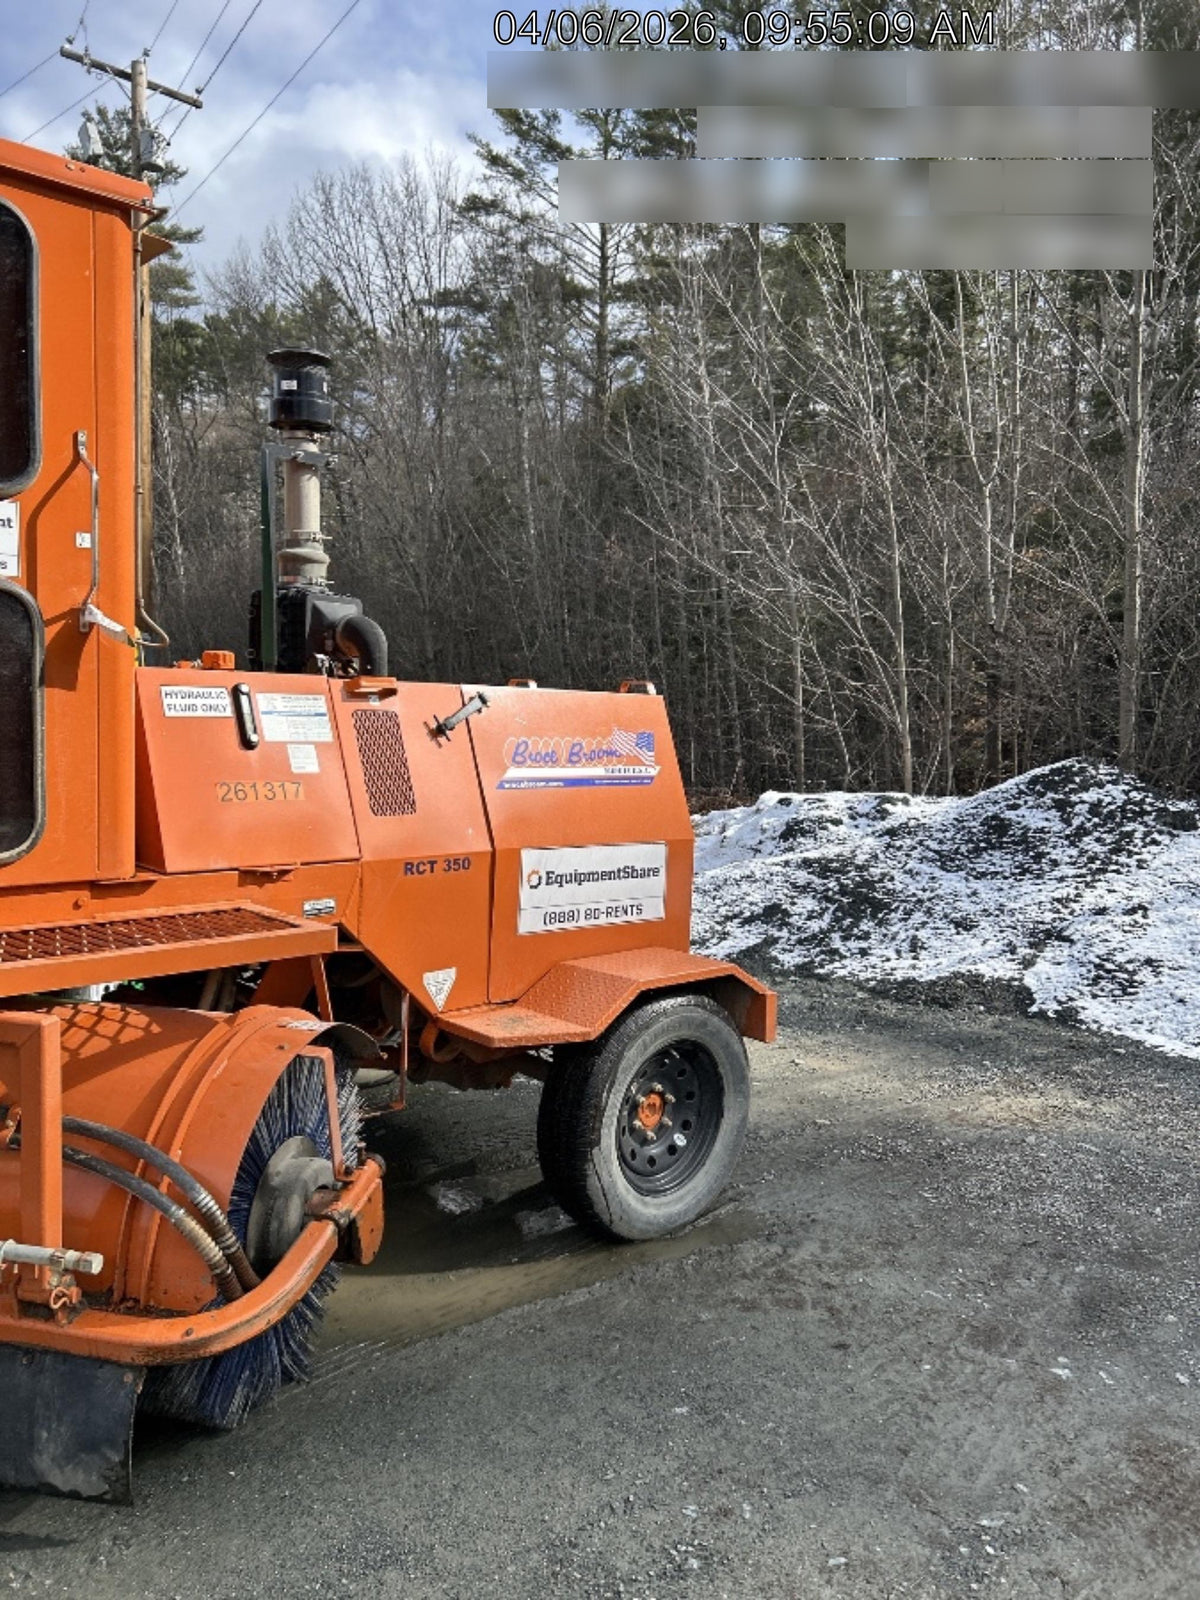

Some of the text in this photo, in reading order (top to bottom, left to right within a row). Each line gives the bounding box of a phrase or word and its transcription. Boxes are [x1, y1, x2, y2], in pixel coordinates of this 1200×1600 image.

[164, 690, 227, 700] HYDRAULIC
[166, 703, 228, 714] FLUID ONLY
[218, 781, 302, 802] 261317
[404, 857, 471, 876] RCT 350
[545, 865, 661, 888] EquipmentShare
[543, 903, 643, 926] (888) 80-RENTS
